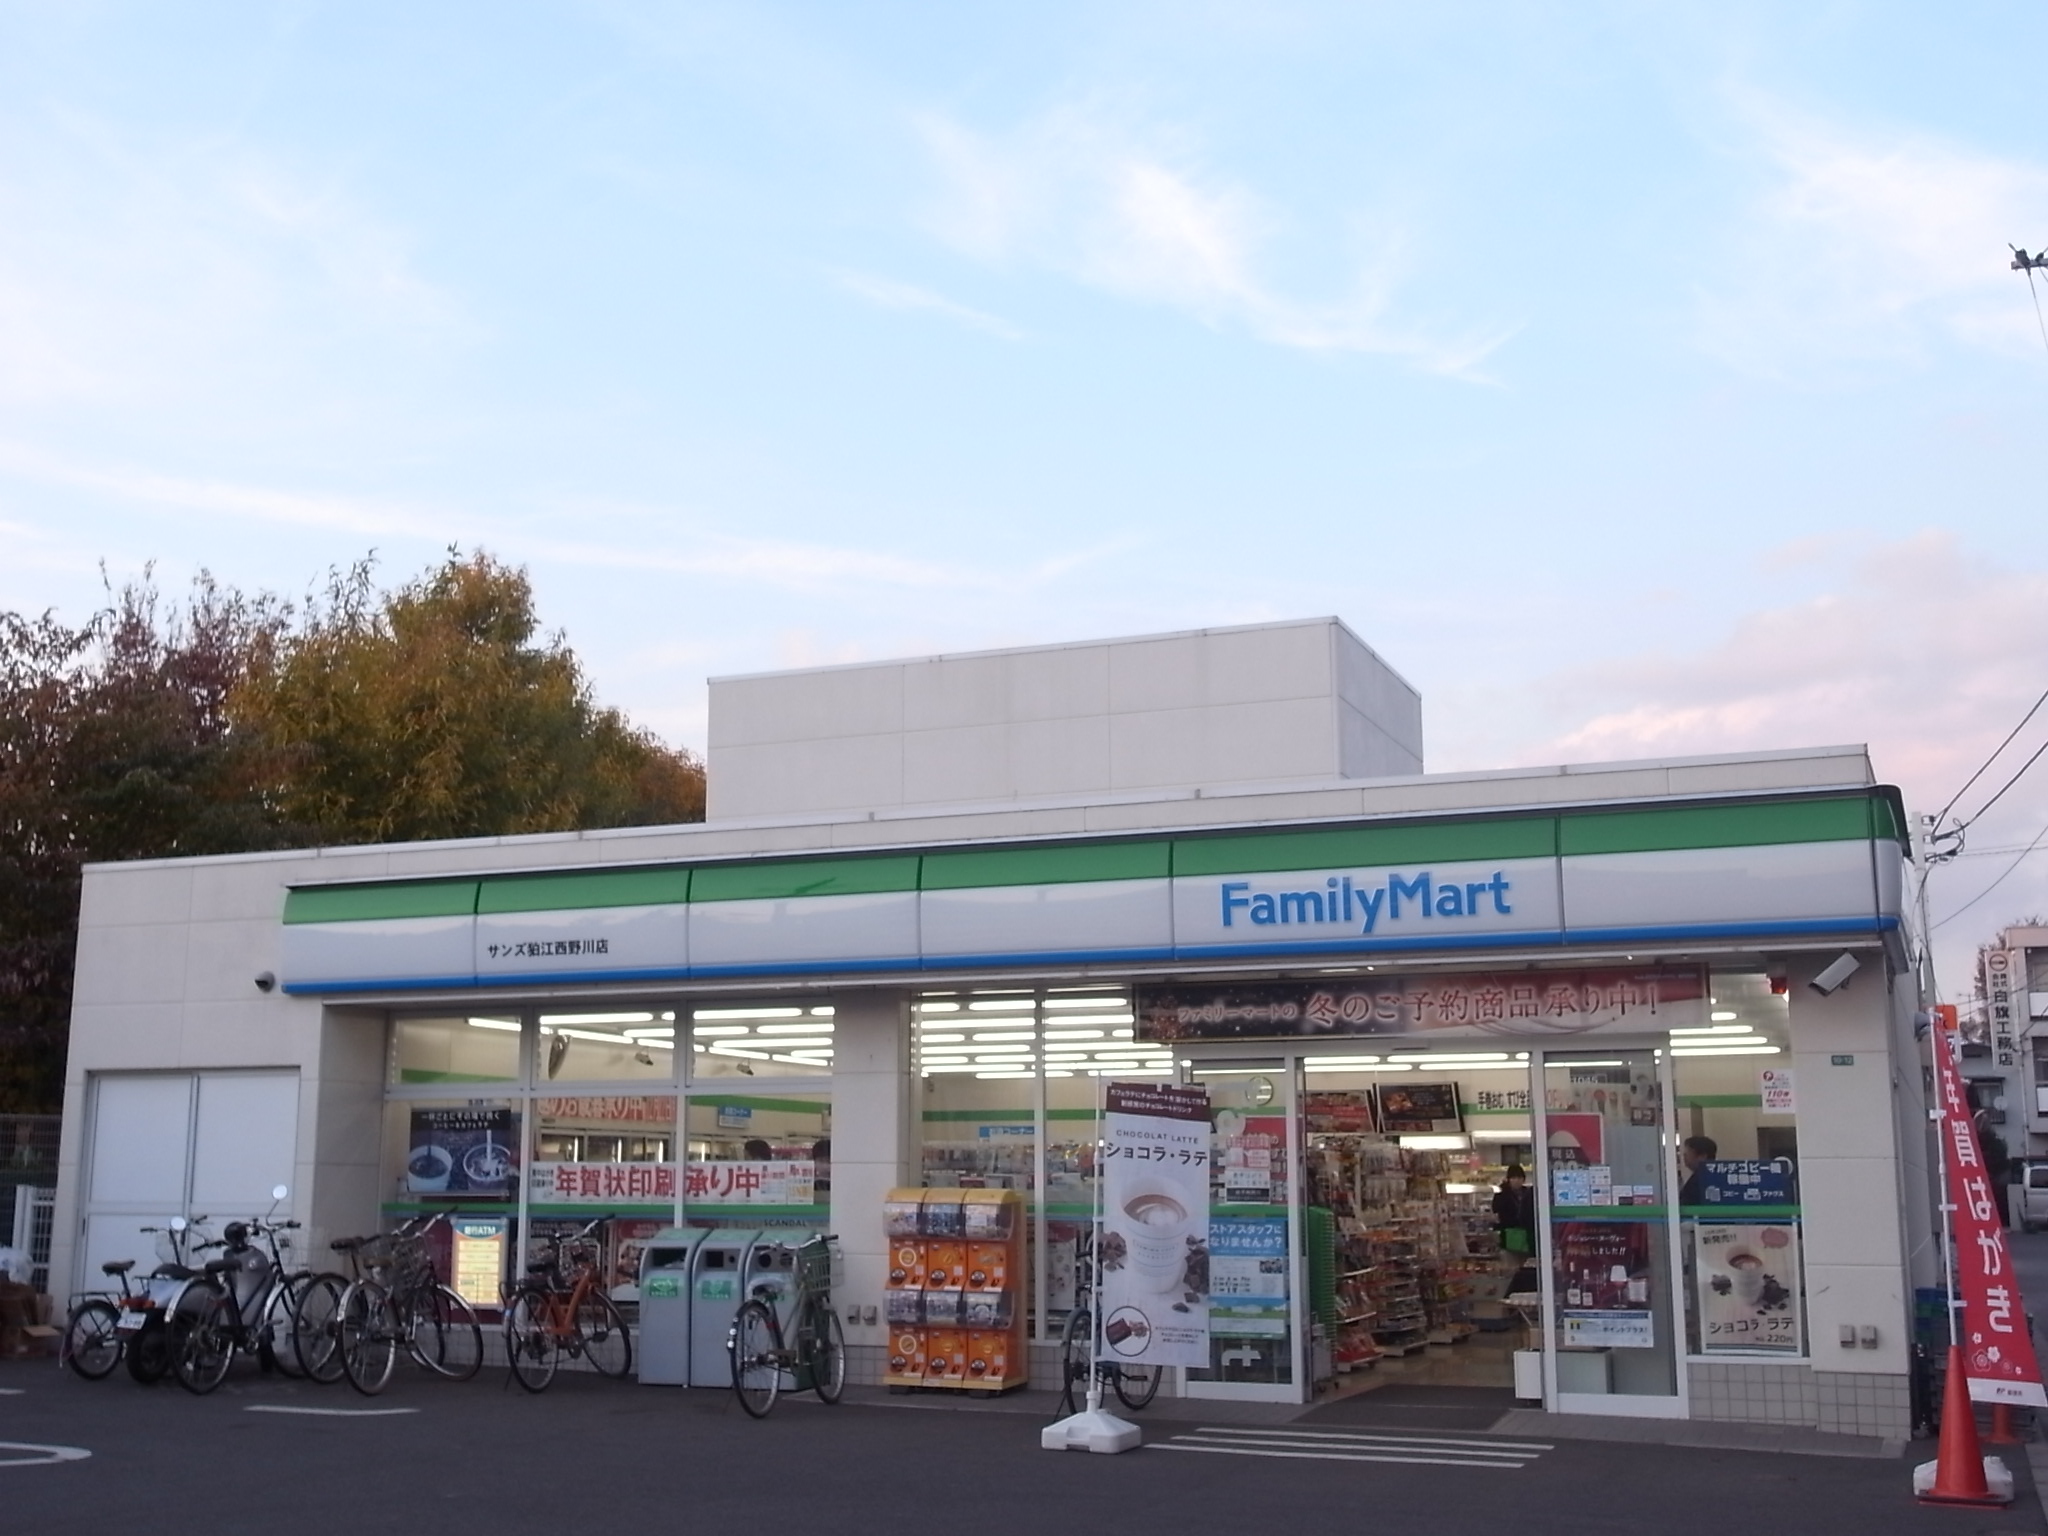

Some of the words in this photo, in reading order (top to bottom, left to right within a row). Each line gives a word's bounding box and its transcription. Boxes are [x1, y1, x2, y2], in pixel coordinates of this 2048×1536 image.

[1222, 870, 1512, 934] FamilyMart
[488, 939, 608, 958] サンズ狛江西野川店
[1116, 1129, 1167, 1140] CHOCOLAT
[1171, 1135, 1199, 1145] LATTE
[1106, 1142, 1207, 1166] ショコラ・ラテ
[556, 1165, 760, 1198] 年賀状印刷承り中
[1210, 1224, 1282, 1235] ストアスタッフに
[1210, 1237, 1282, 1248] なりませんか?
[1710, 1317, 1794, 1335] ショコラ・ラテ
